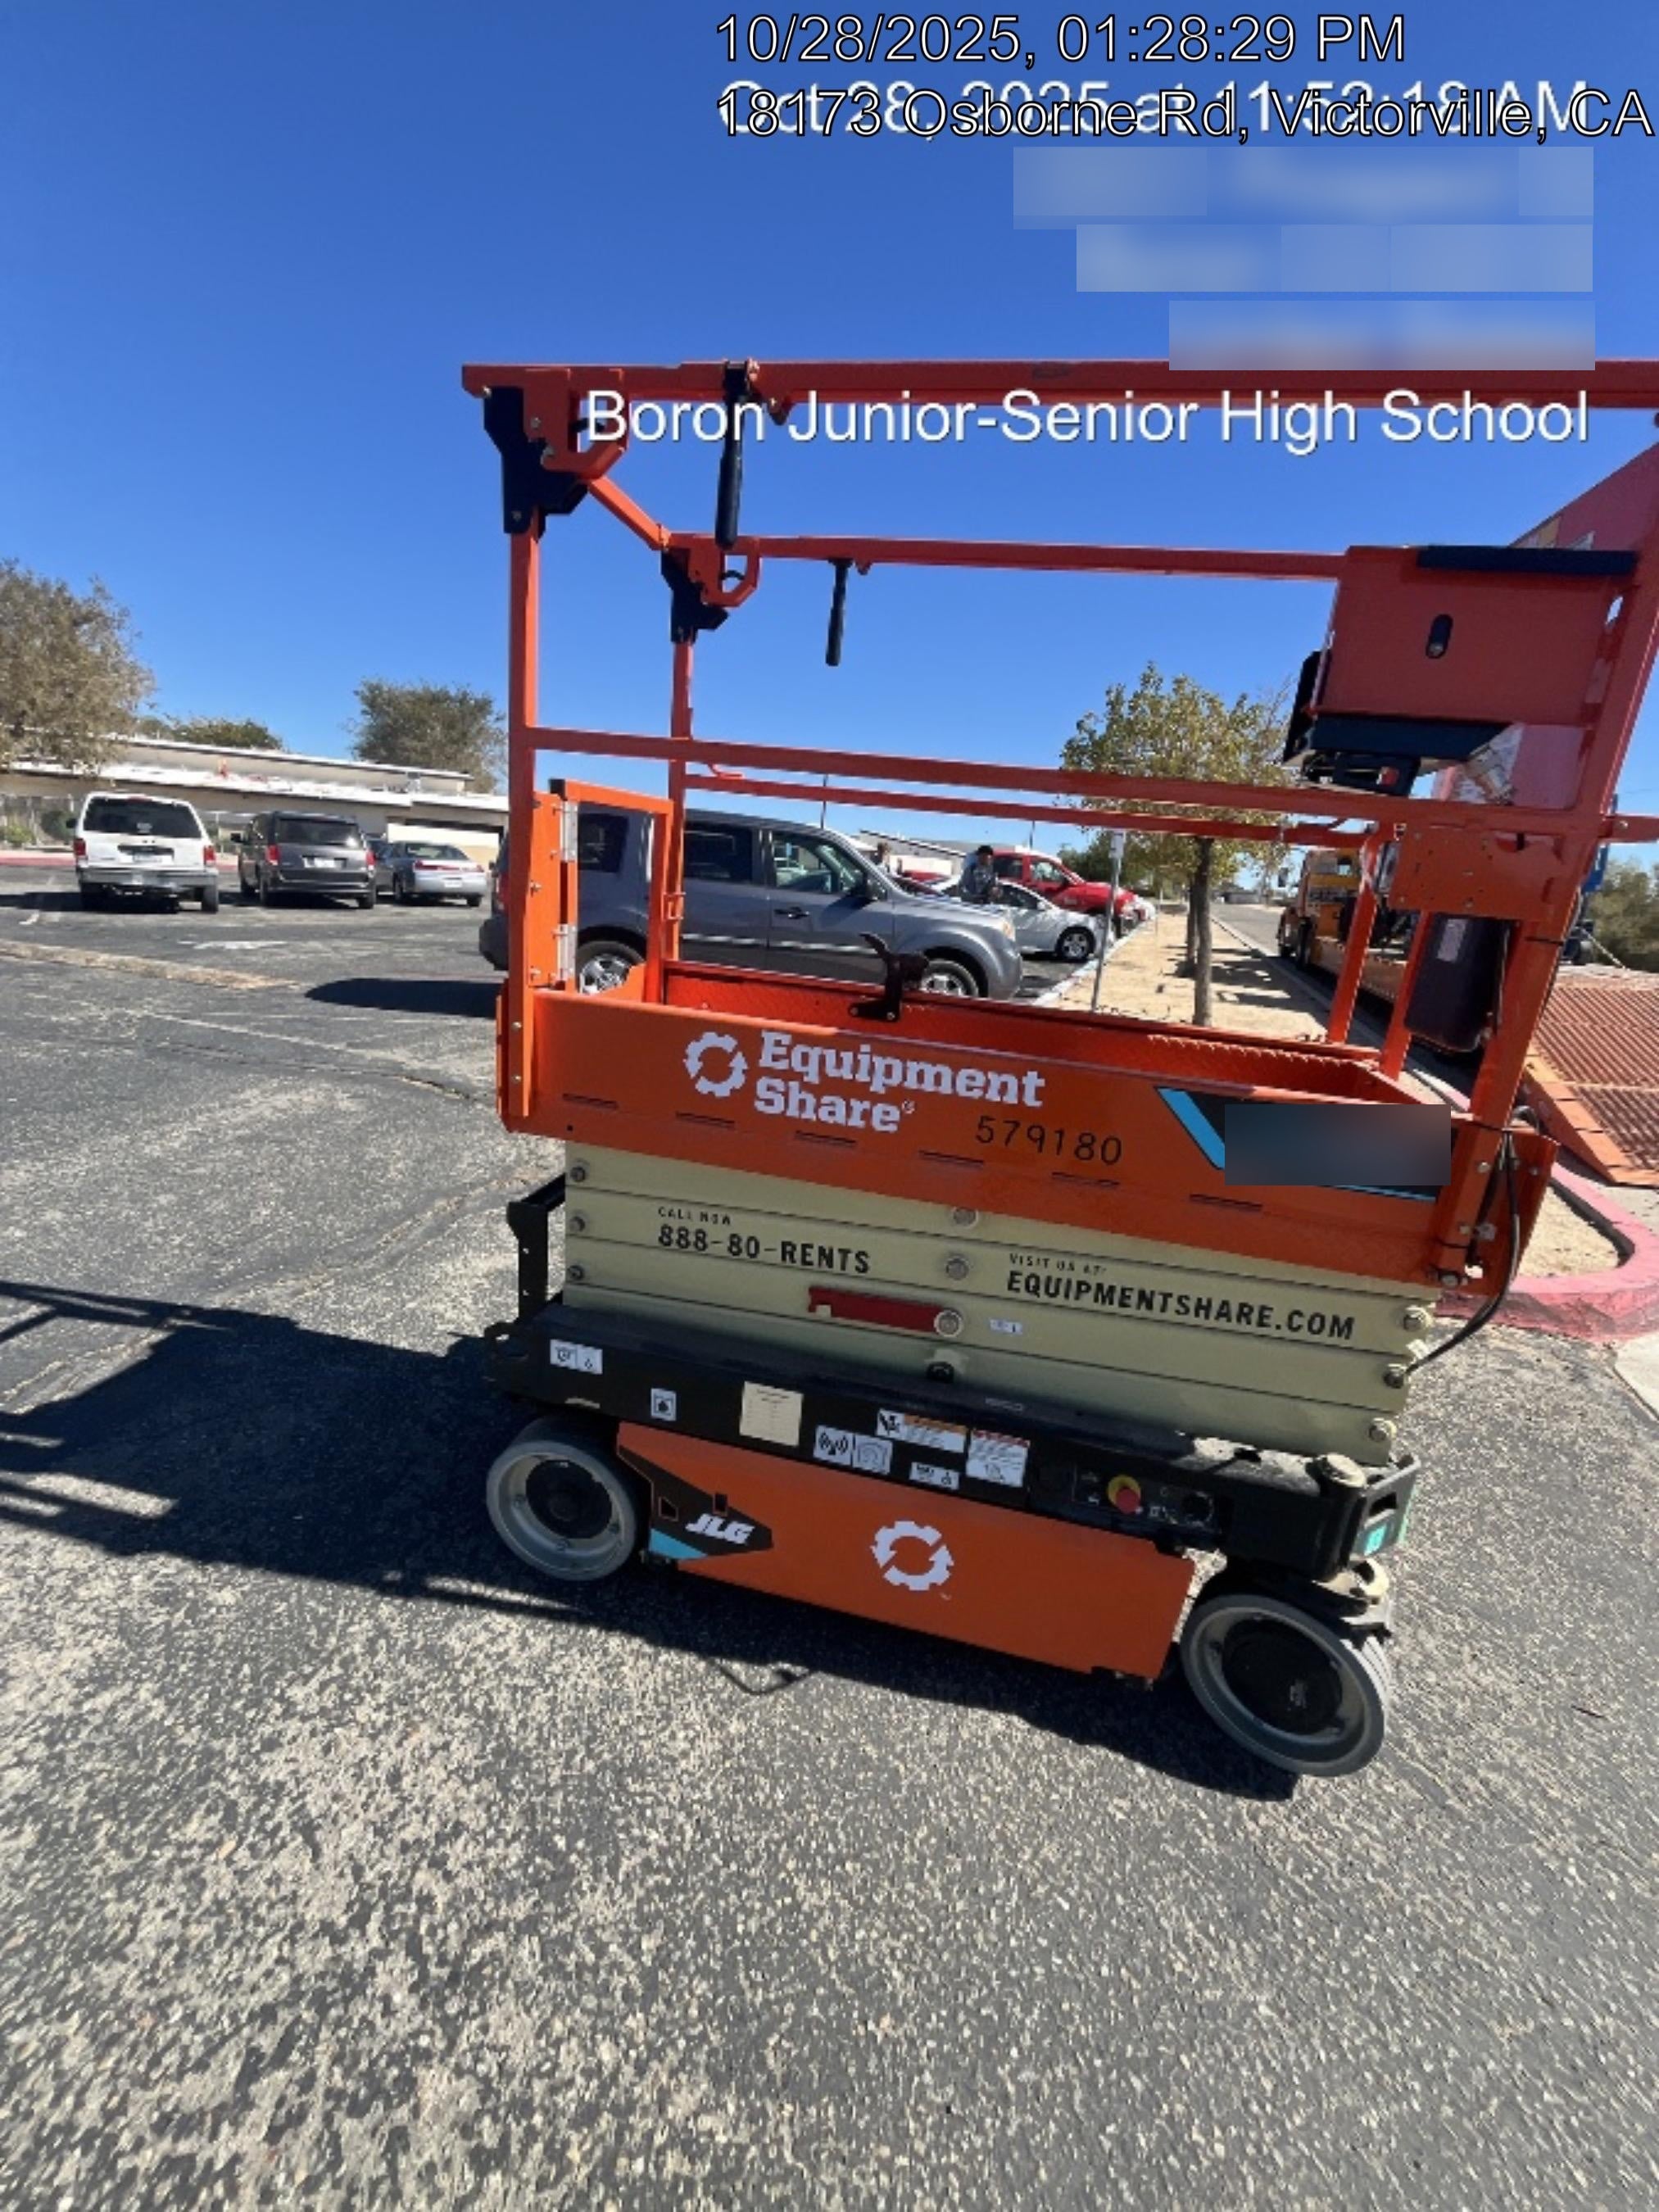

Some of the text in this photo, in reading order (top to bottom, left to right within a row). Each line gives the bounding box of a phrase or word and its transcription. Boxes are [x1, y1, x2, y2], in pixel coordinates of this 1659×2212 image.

[759, 1029, 1045, 1108] Equipment
[754, 1077, 901, 1133] Share
[976, 1115, 1122, 1166] 579180
[658, 1224, 871, 1274] 888-80-RENTS
[1007, 1270, 1355, 1341] EQUIPMENTSHARE.COM
[685, 1513, 755, 1545] JLG
